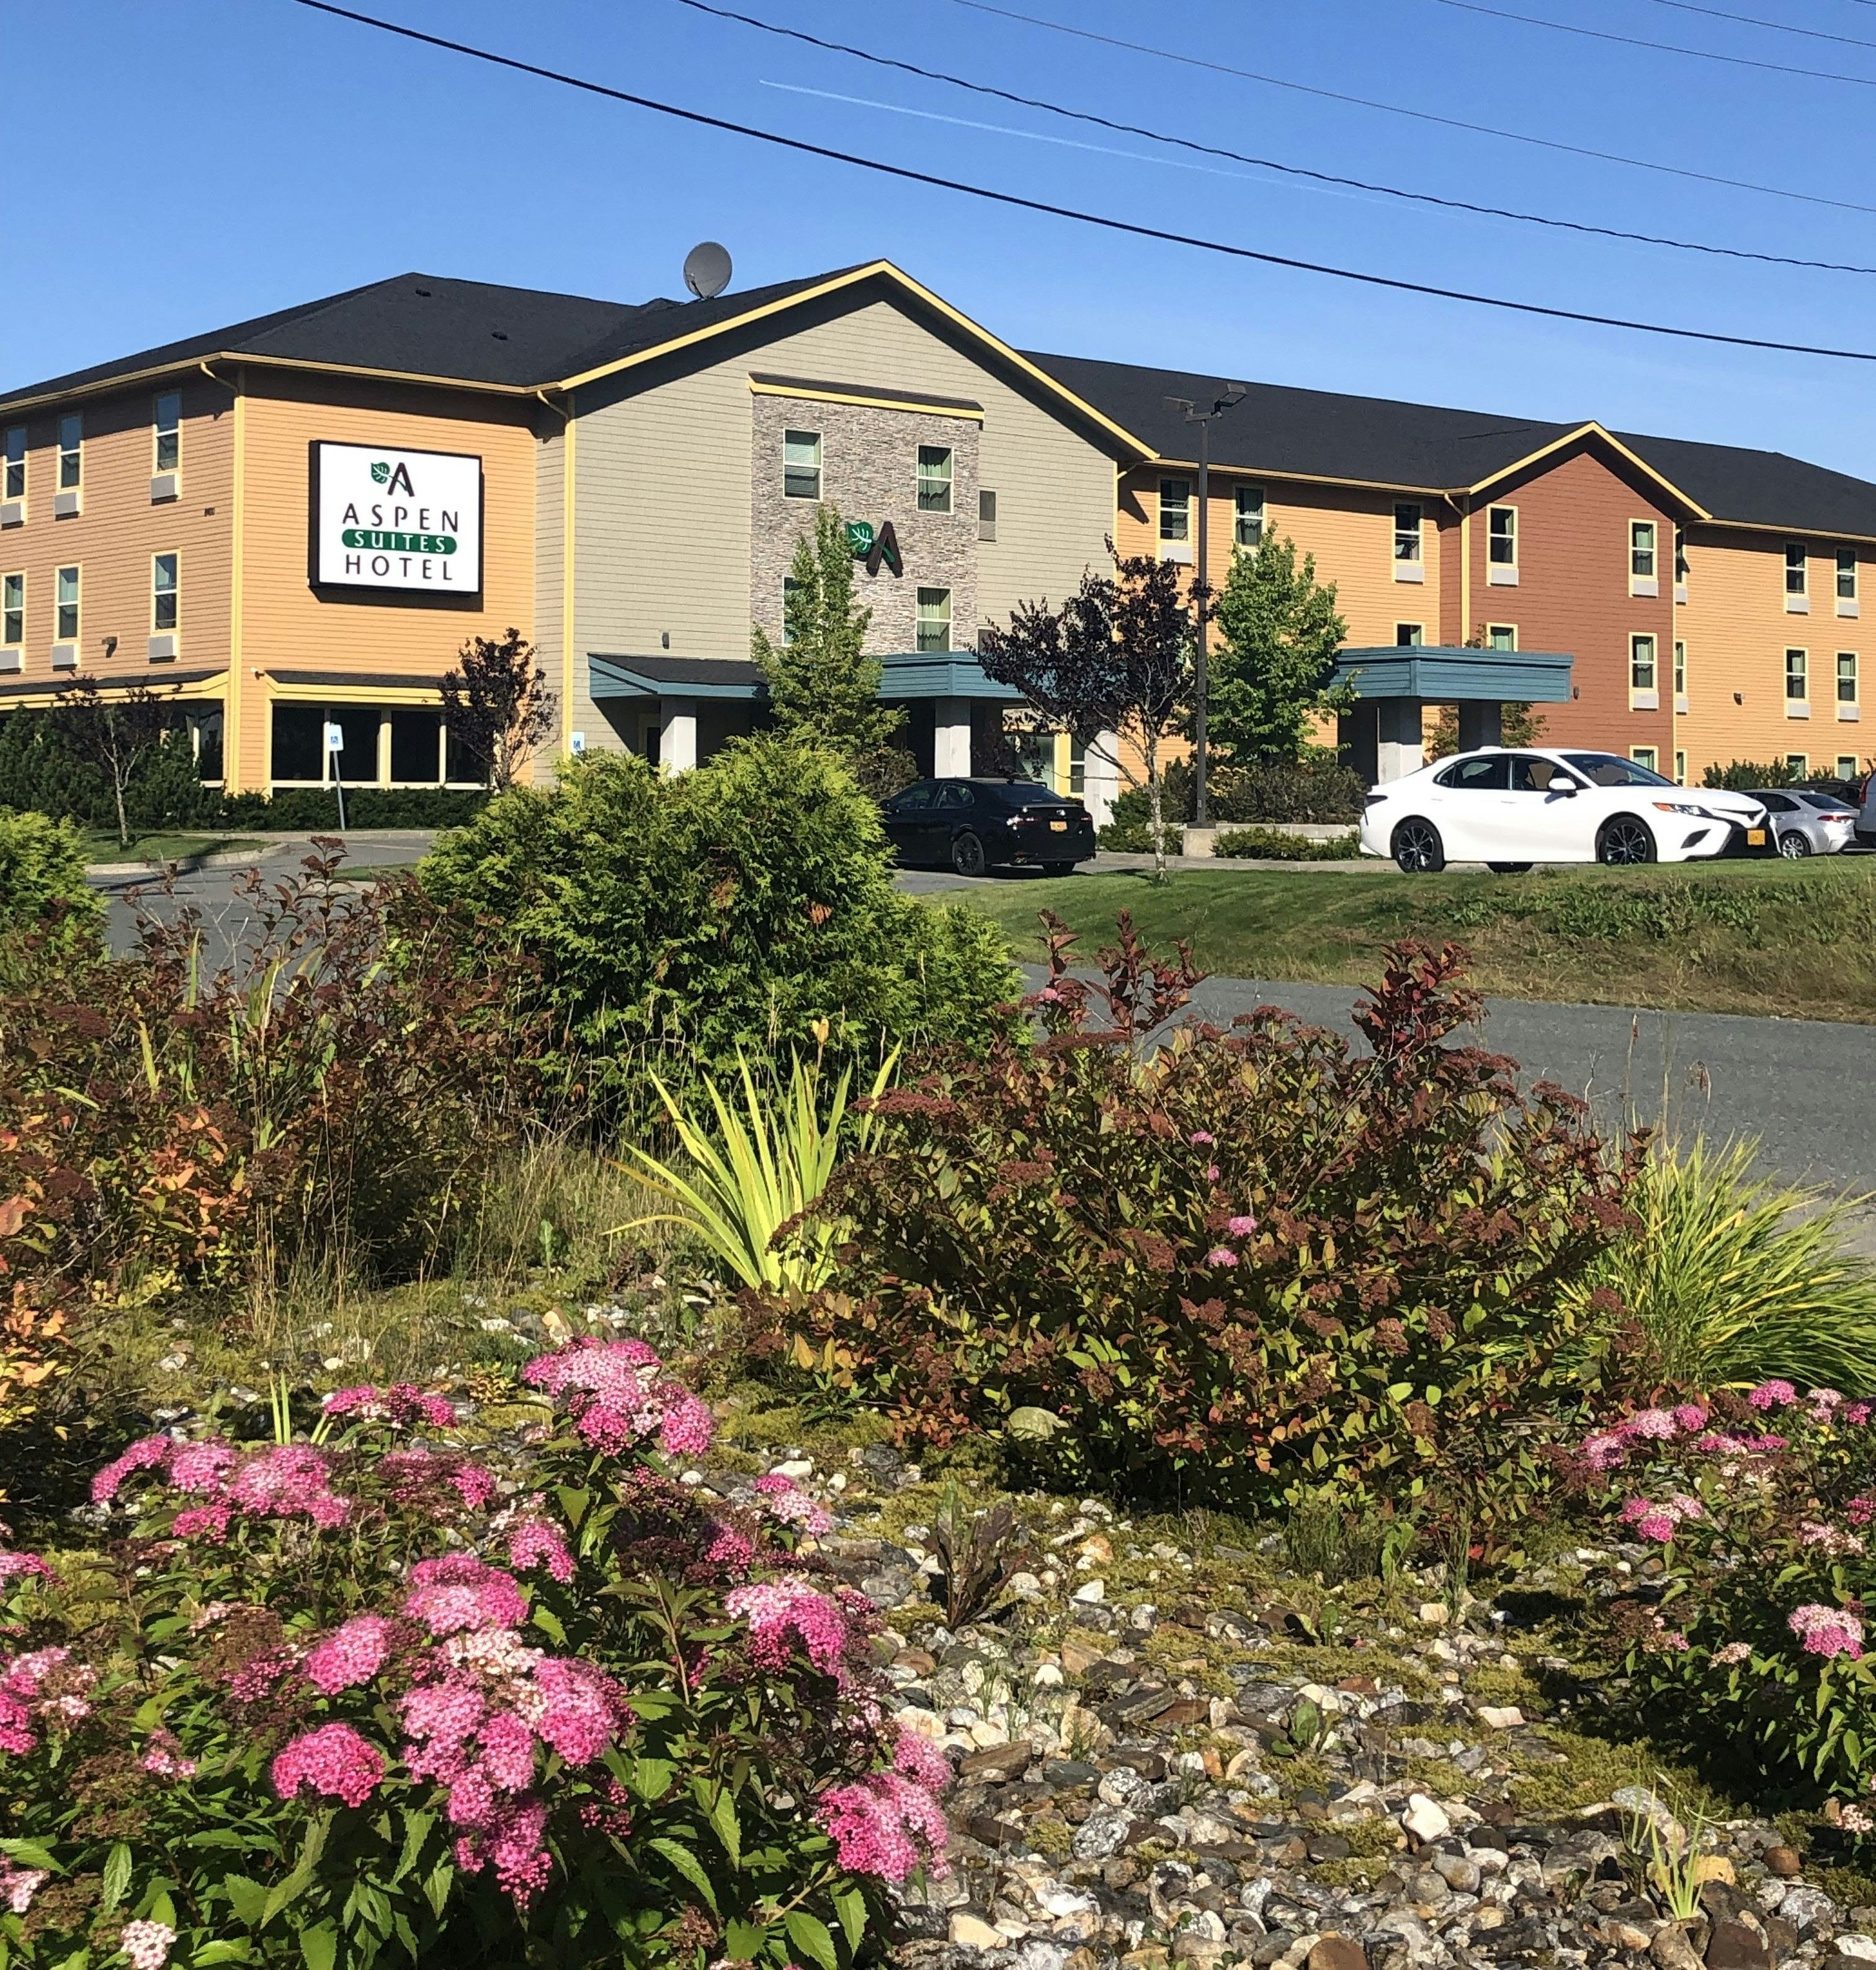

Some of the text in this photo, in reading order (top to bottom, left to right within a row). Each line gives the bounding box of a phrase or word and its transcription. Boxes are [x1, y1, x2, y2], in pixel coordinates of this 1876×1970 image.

[342, 503, 458, 532] ASPEN
[354, 531, 445, 553] SUITES
[345, 554, 453, 581] HOTEL
